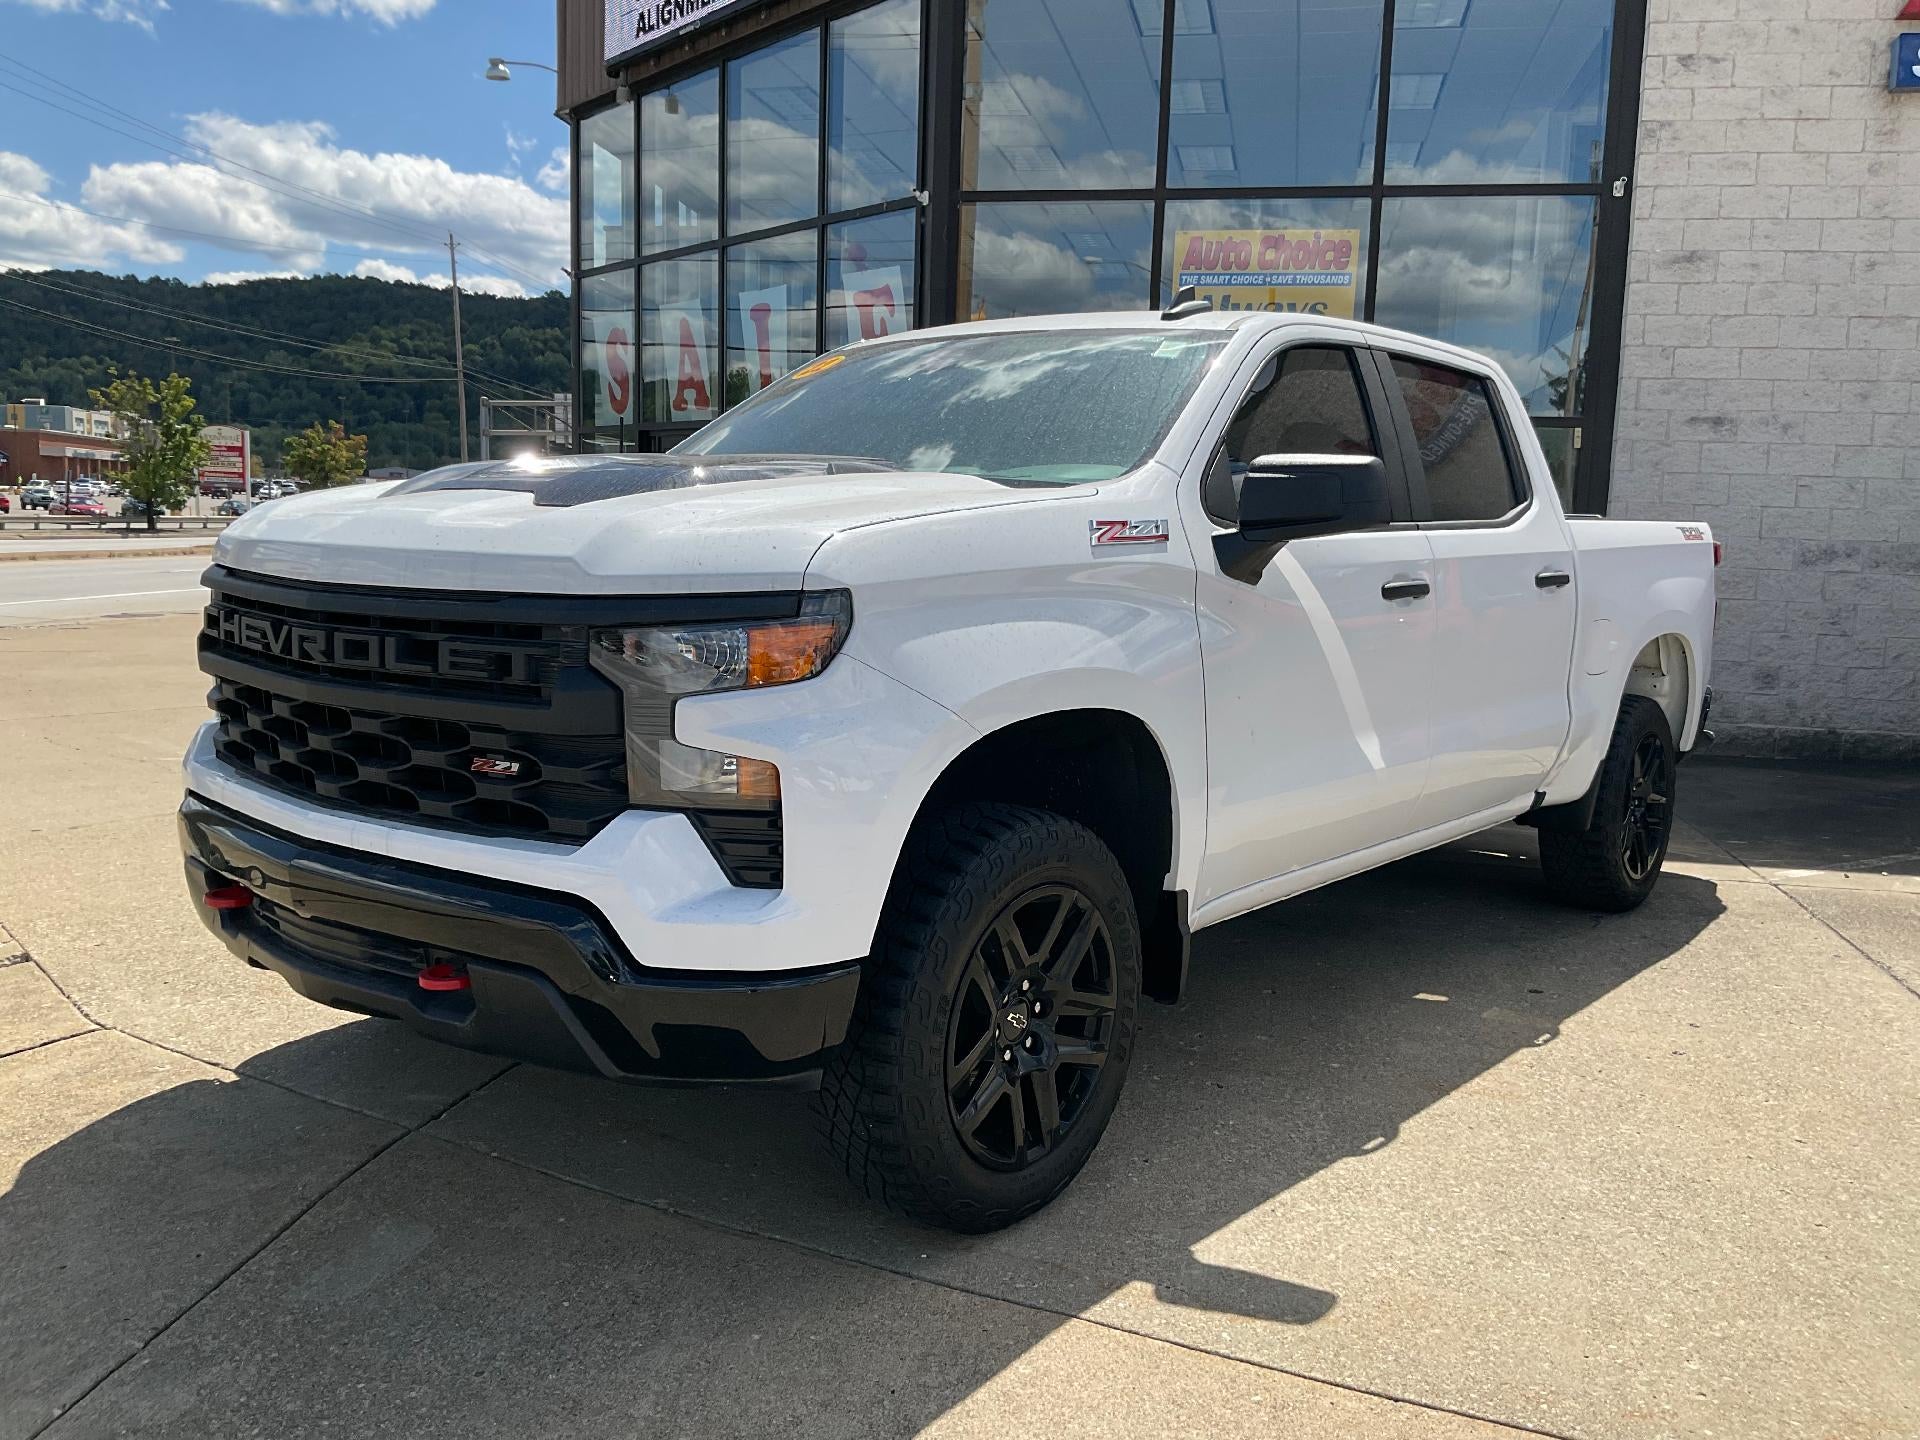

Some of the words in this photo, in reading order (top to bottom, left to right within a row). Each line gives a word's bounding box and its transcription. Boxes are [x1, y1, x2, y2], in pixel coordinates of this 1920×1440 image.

[1181, 236, 1253, 271] Auto
[1256, 231, 1353, 271] Choice
[1181, 275, 1199, 285] THE
[1200, 275, 1231, 285] SMART
[1231, 275, 1263, 285] CHOICE
[1270, 275, 1294, 285] SAVE
[1295, 274, 1350, 285] THOUSANDS
[1091, 519, 1170, 545] Z71
[203, 604, 545, 682] CHEVROLET
[471, 757, 520, 776] Z71
